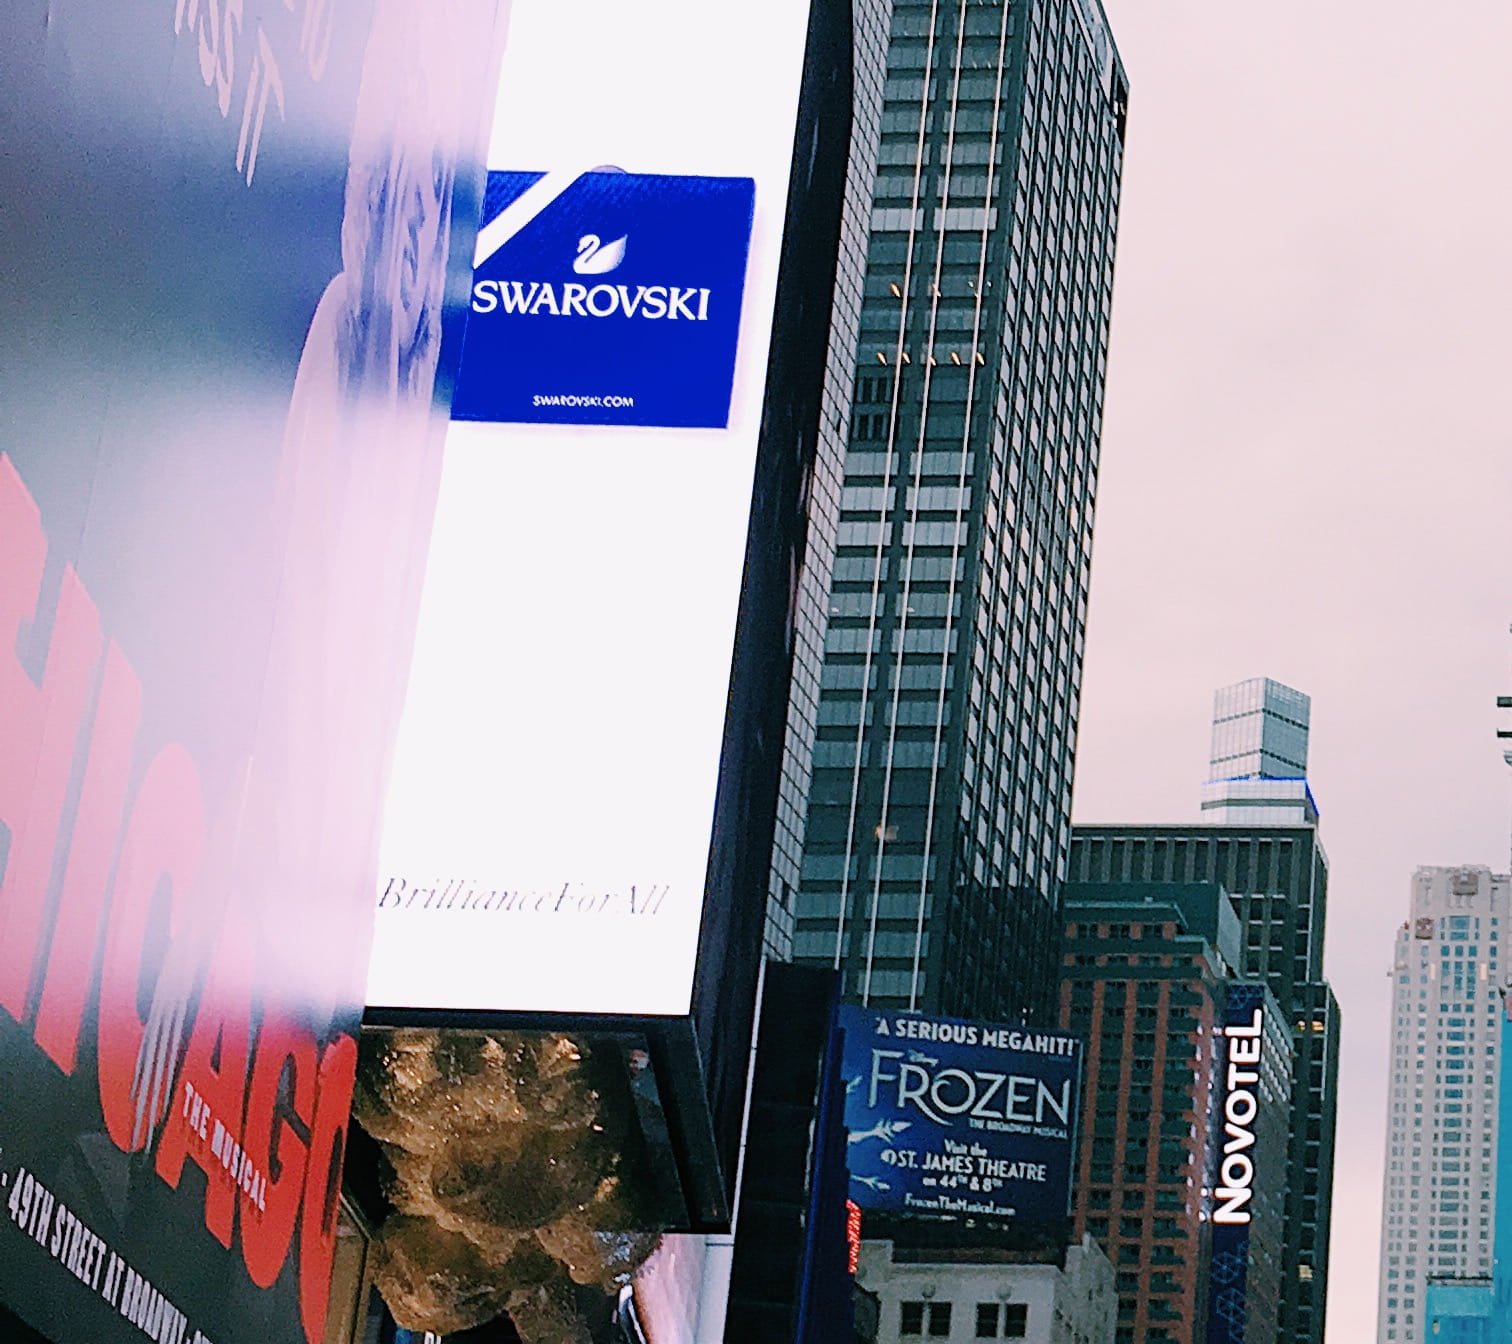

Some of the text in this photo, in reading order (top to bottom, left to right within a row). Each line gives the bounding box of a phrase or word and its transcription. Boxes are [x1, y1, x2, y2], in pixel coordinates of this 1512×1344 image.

[472, 279, 711, 321] SWAROVSKI
[532, 395, 634, 408] SWAROVSKI.COM
[895, 1018, 977, 1046] SERIOUS
[869, 1048, 1071, 1126] FROZEN
[1213, 1008, 1263, 1224] NOVOTEL
[922, 1152, 974, 1174] JAMES
[978, 1159, 1047, 1182] THEATRE
[9, 1167, 54, 1248] 49TH
[51, 1202, 107, 1291] STREET
[102, 1251, 125, 1307] AT
